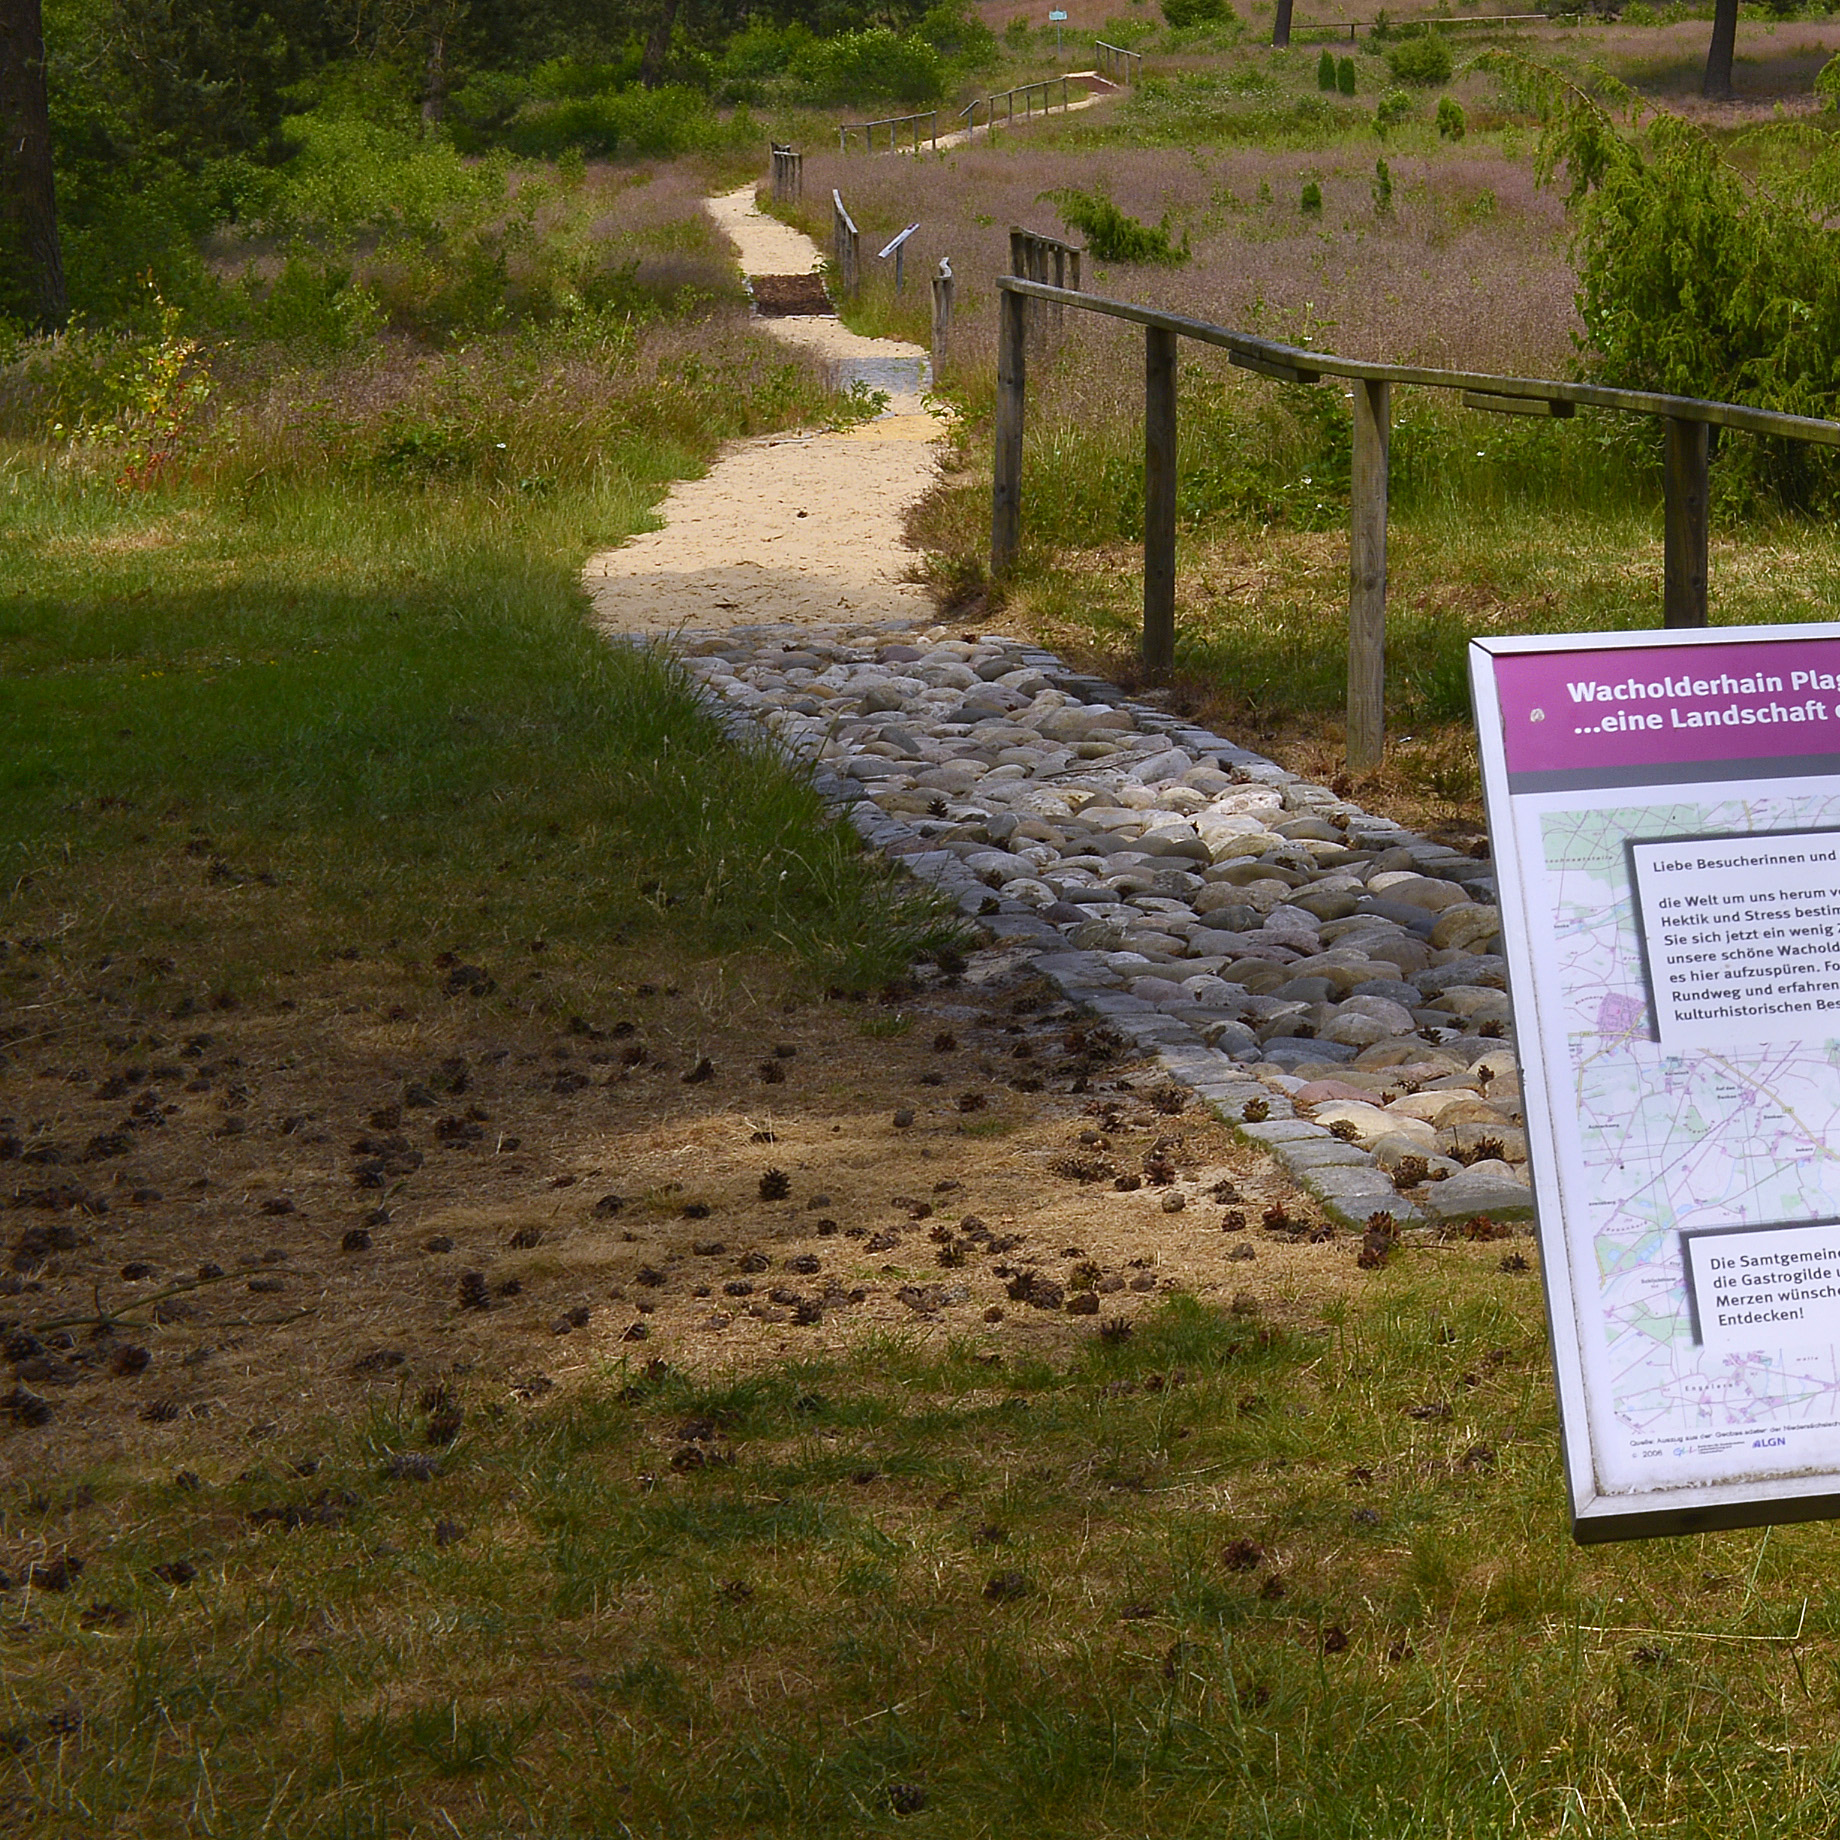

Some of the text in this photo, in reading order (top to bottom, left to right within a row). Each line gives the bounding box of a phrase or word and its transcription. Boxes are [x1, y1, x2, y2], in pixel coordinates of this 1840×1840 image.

[1566, 672, 1783, 703] Wacholderhain
[1670, 700, 1828, 728] Landschaft
[1653, 860, 1692, 872] Liebe
[1697, 854, 1805, 869] Besucherinnen
[1810, 850, 1837, 862] und
[1659, 897, 1681, 909] die
[1684, 895, 1719, 907] Welt
[1722, 895, 1745, 904] um
[1749, 893, 1776, 903] uns
[1779, 890, 1826, 900] herum
[1661, 914, 1709, 927] Hektik
[1713, 911, 1740, 923] und
[1745, 910, 1791, 921] Stress
[1664, 934, 1687, 946] Sie
[1692, 931, 1721, 944] sich
[1726, 929, 1759, 944] jetzt
[1763, 927, 1785, 939] ein
[1789, 923, 1834, 937] wenig
[1667, 953, 1716, 964] unsere
[1721, 947, 1774, 960] schöne
[1669, 974, 1686, 983] es
[1690, 970, 1720, 981] hier
[1724, 964, 1821, 979] aufzuspüren.
[1672, 988, 1741, 1002] Rundweg
[1745, 984, 1773, 997] und
[1778, 981, 1840, 994] erfahren
[1674, 1001, 1812, 1021] kulturhistorischen
[1710, 1257, 1735, 1270] Die
[1713, 1276, 1737, 1288] die
[1741, 1267, 1831, 1286] Gastrogilde
[1716, 1294, 1773, 1307] Merzen
[1718, 1307, 1804, 1326] Entdecken!
